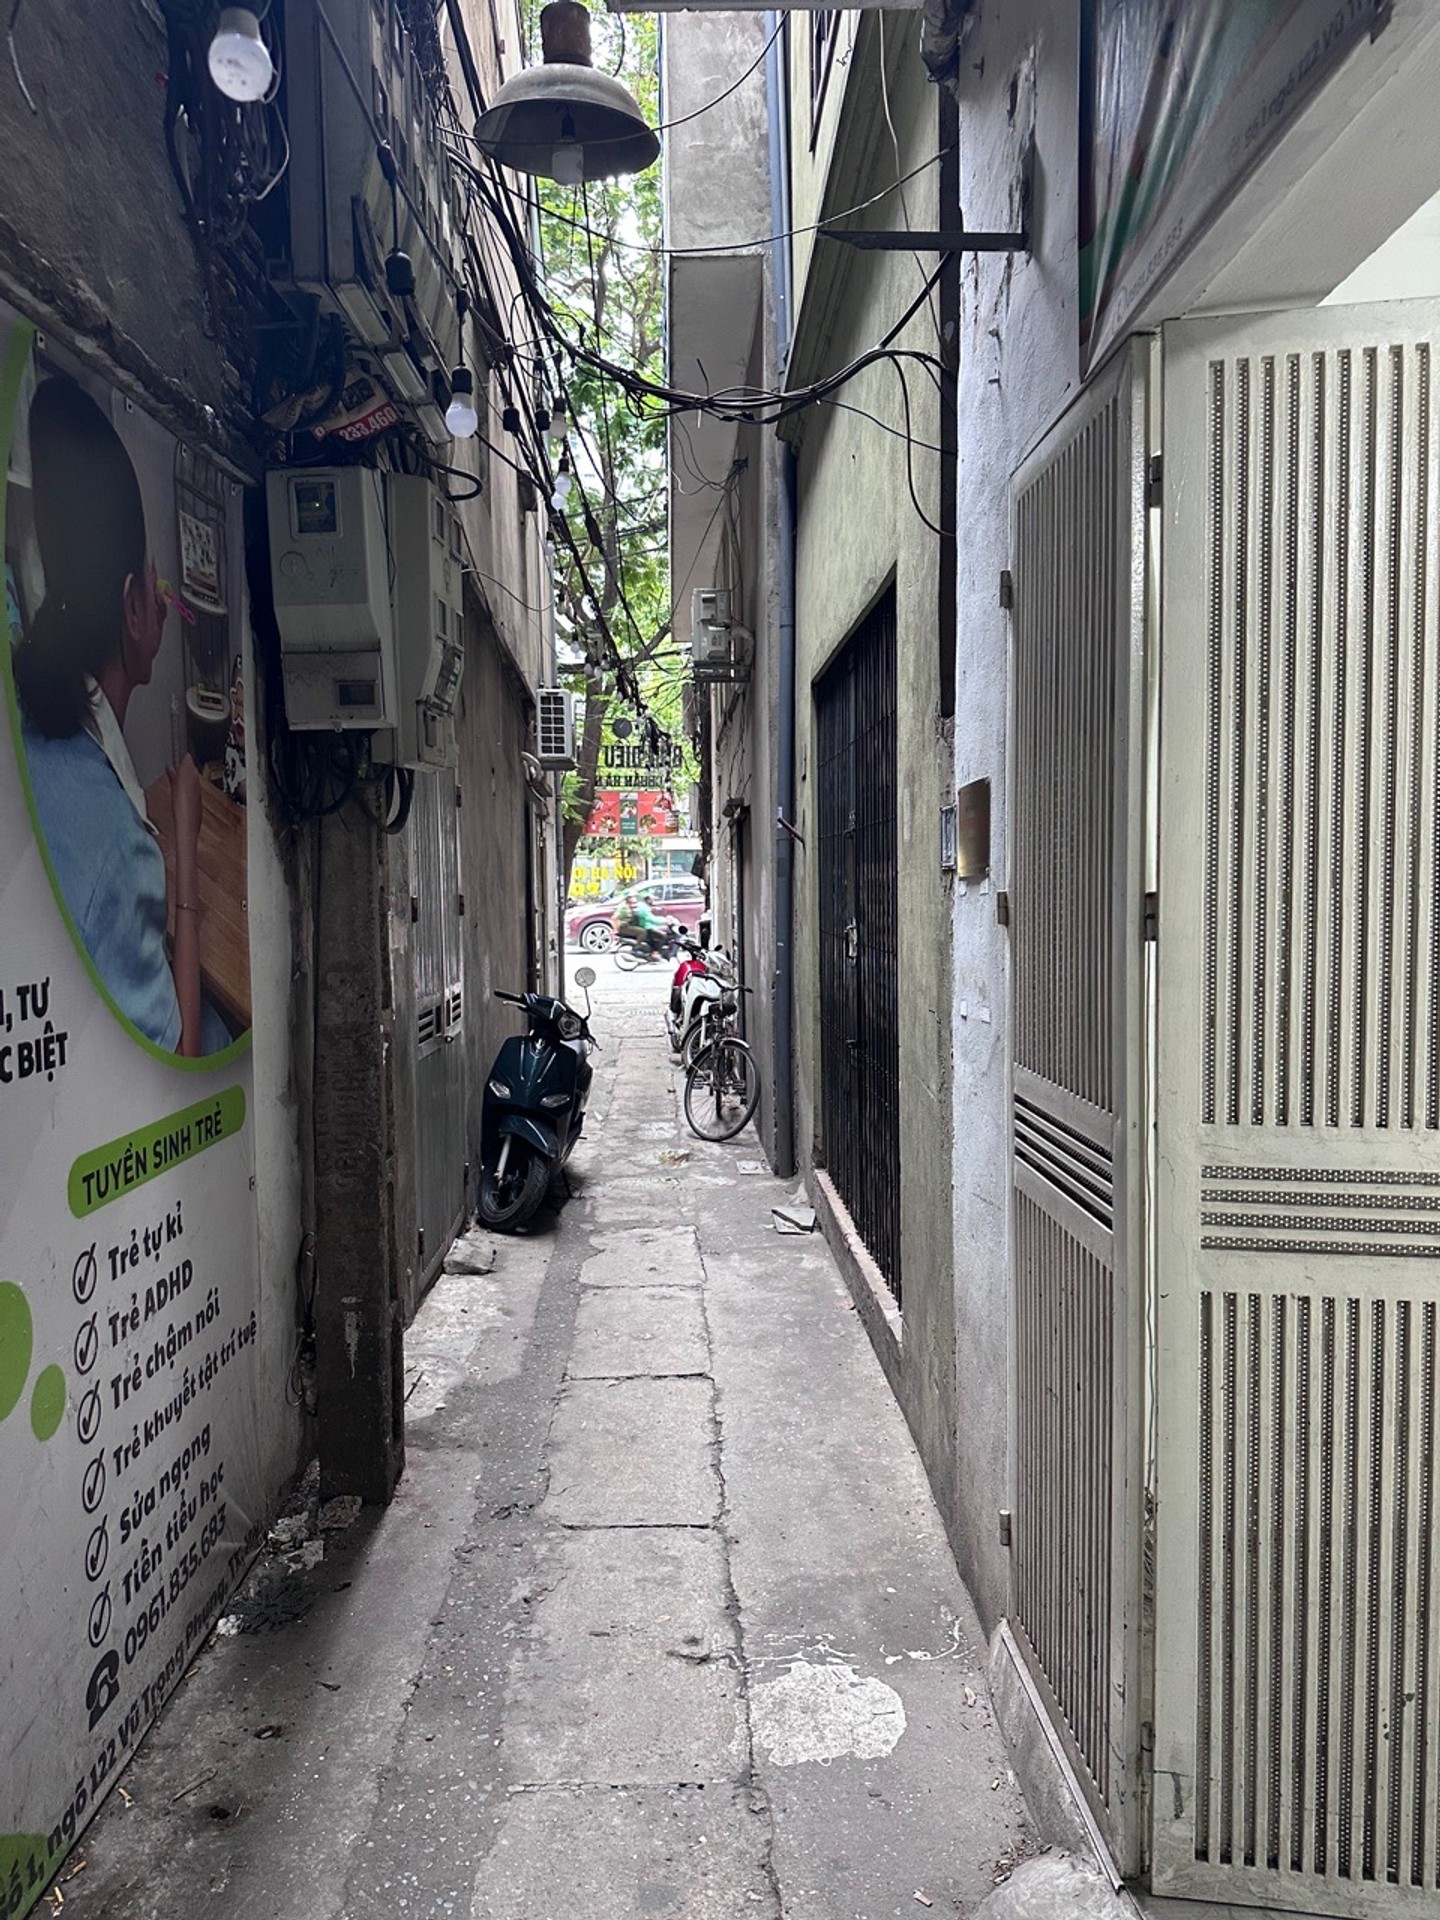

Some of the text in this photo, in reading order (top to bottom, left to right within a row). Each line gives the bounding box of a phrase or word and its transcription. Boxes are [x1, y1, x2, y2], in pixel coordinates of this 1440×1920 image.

[16, 976, 50, 1021] TƯ
[18, 1020, 68, 1083] BIỆT
[82, 1101, 224, 1205] TUYỂN SINH TRẺ
[108, 1200, 183, 1281] Trẻ tự kỉ
[108, 1258, 194, 1348] Trẻ ADHD
[110, 1286, 221, 1410] Trẻ chậm nói
[112, 1310, 257, 1477] Trẻ khuyết tật trí tuệ
[120, 1423, 211, 1545] Sửa ngọng
[122, 1461, 224, 1605] Tiền tiểu học
[124, 1501, 227, 1665] 0961.835.683
[90, 1738, 117, 1798] 122
[118, 1699, 140, 1749] Vũ
[142, 1639, 184, 1718] Trọng
